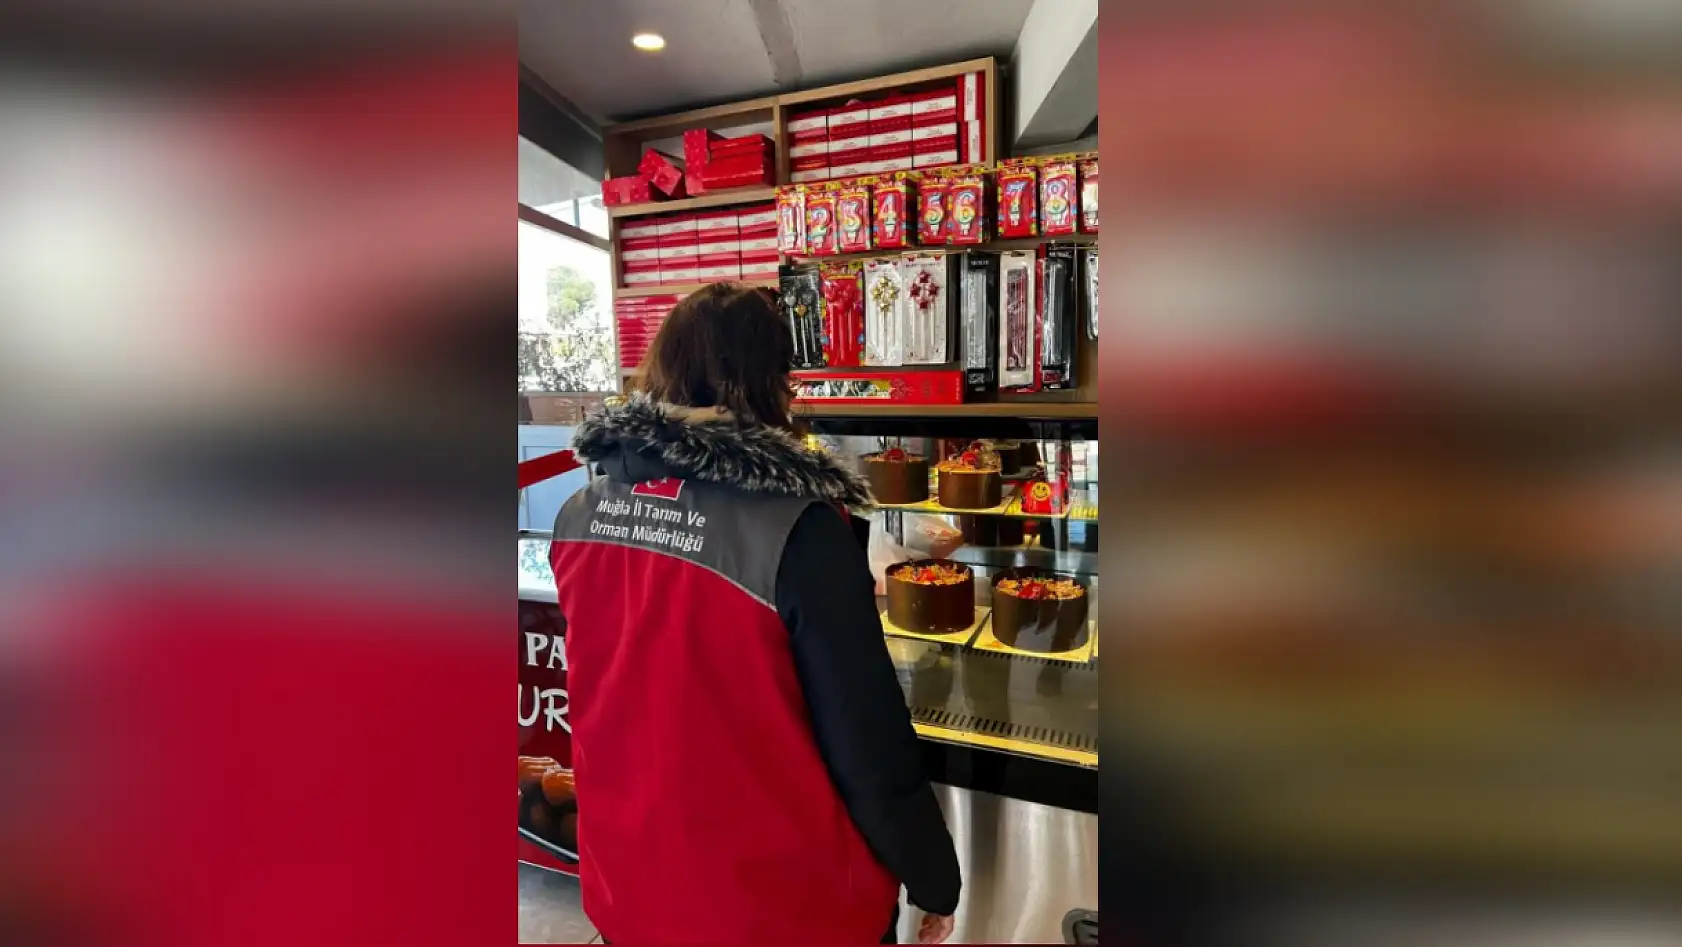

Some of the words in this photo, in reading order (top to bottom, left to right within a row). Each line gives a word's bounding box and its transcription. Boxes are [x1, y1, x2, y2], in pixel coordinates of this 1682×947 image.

[878, 193, 897, 225] 4
[924, 192, 944, 225] 5
[953, 190, 976, 224] 6
[1005, 180, 1028, 214] 7
[1045, 179, 1068, 214] 8
[841, 200, 862, 232] 3
[596, 498, 631, 517] Muğla
[644, 503, 682, 523] Tarım
[687, 510, 706, 527] Ve
[590, 519, 629, 538] Orman
[632, 525, 704, 552] Müdürlüğü
